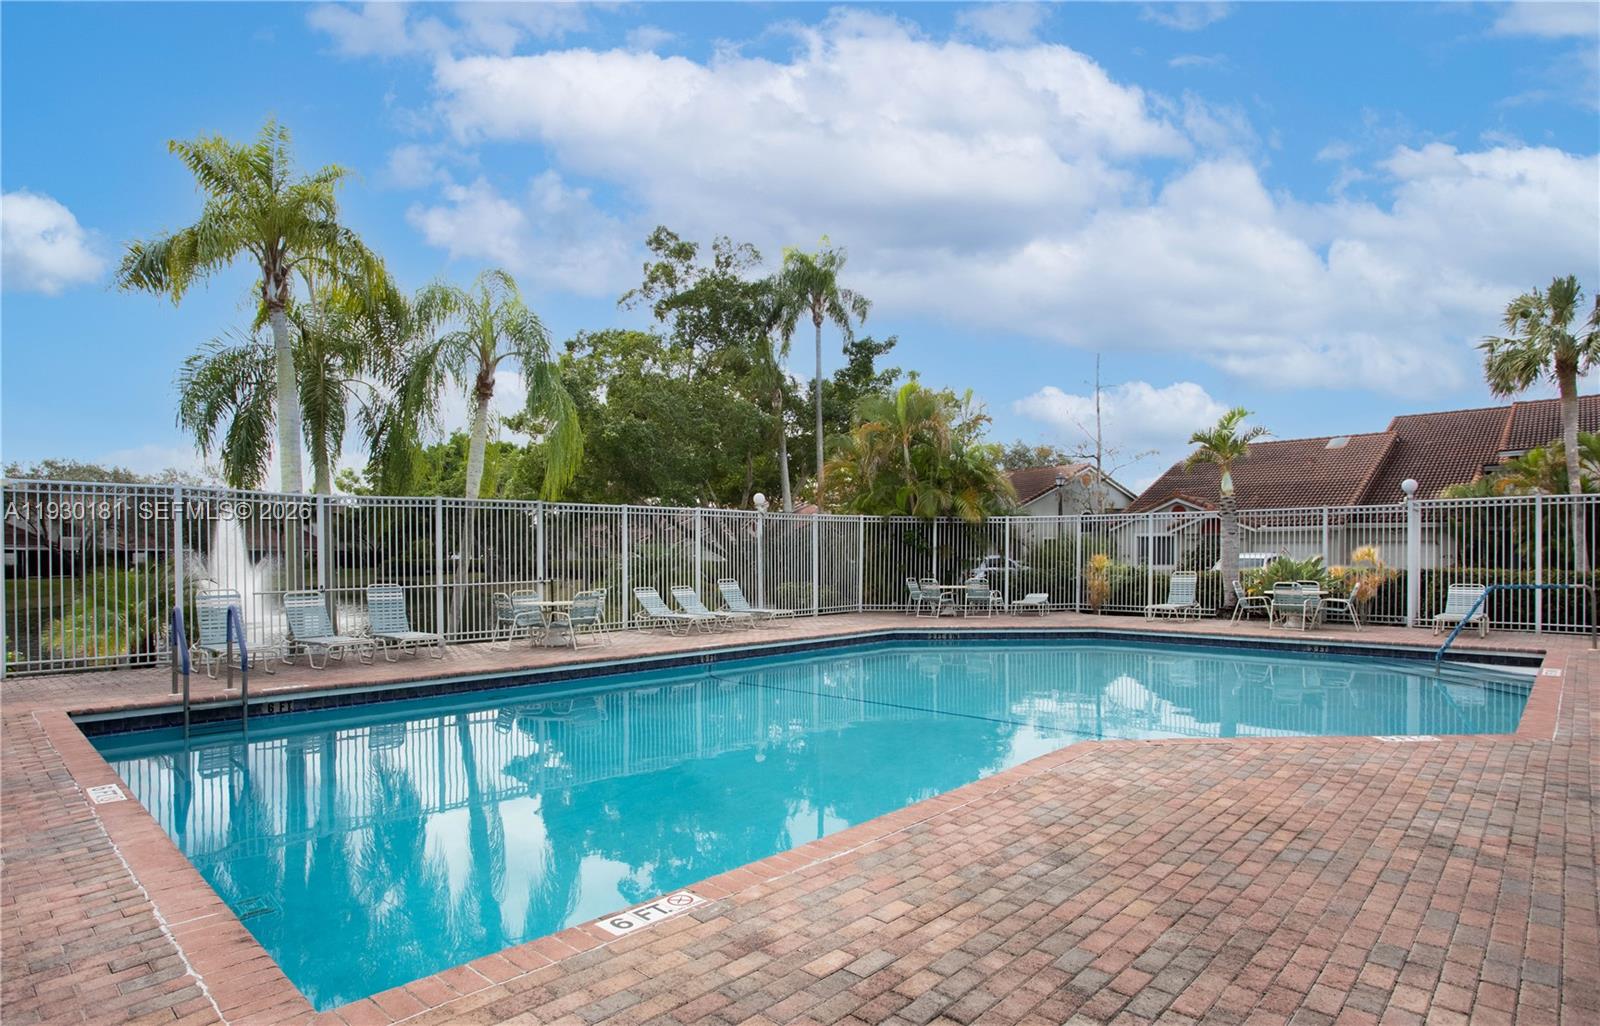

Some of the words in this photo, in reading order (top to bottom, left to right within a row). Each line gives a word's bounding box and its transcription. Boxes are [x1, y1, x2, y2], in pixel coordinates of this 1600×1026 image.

[267, 702, 274, 713] 6
[609, 918, 634, 930] 6
[632, 903, 673, 921] FT.
